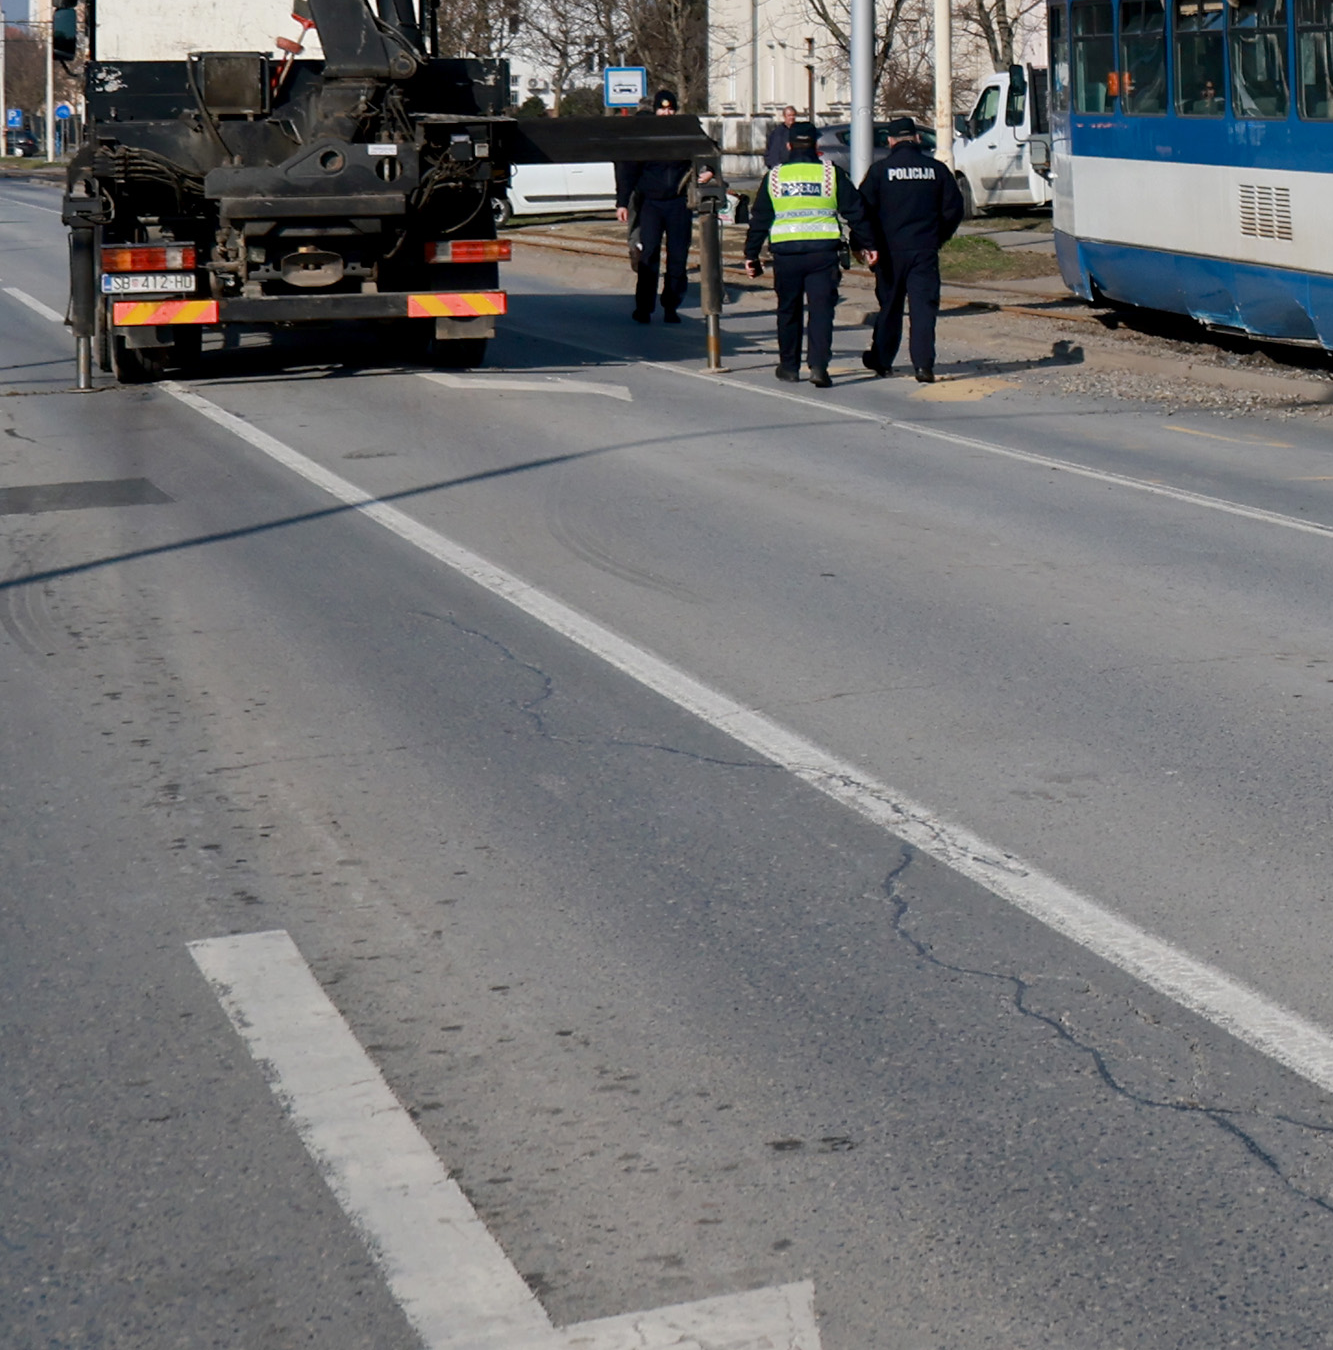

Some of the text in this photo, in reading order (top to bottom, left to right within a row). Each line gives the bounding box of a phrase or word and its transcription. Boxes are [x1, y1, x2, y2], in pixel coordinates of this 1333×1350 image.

[8, 110, 18, 121] P
[887, 166, 937, 181] POLICIJA
[113, 275, 131, 290] SB
